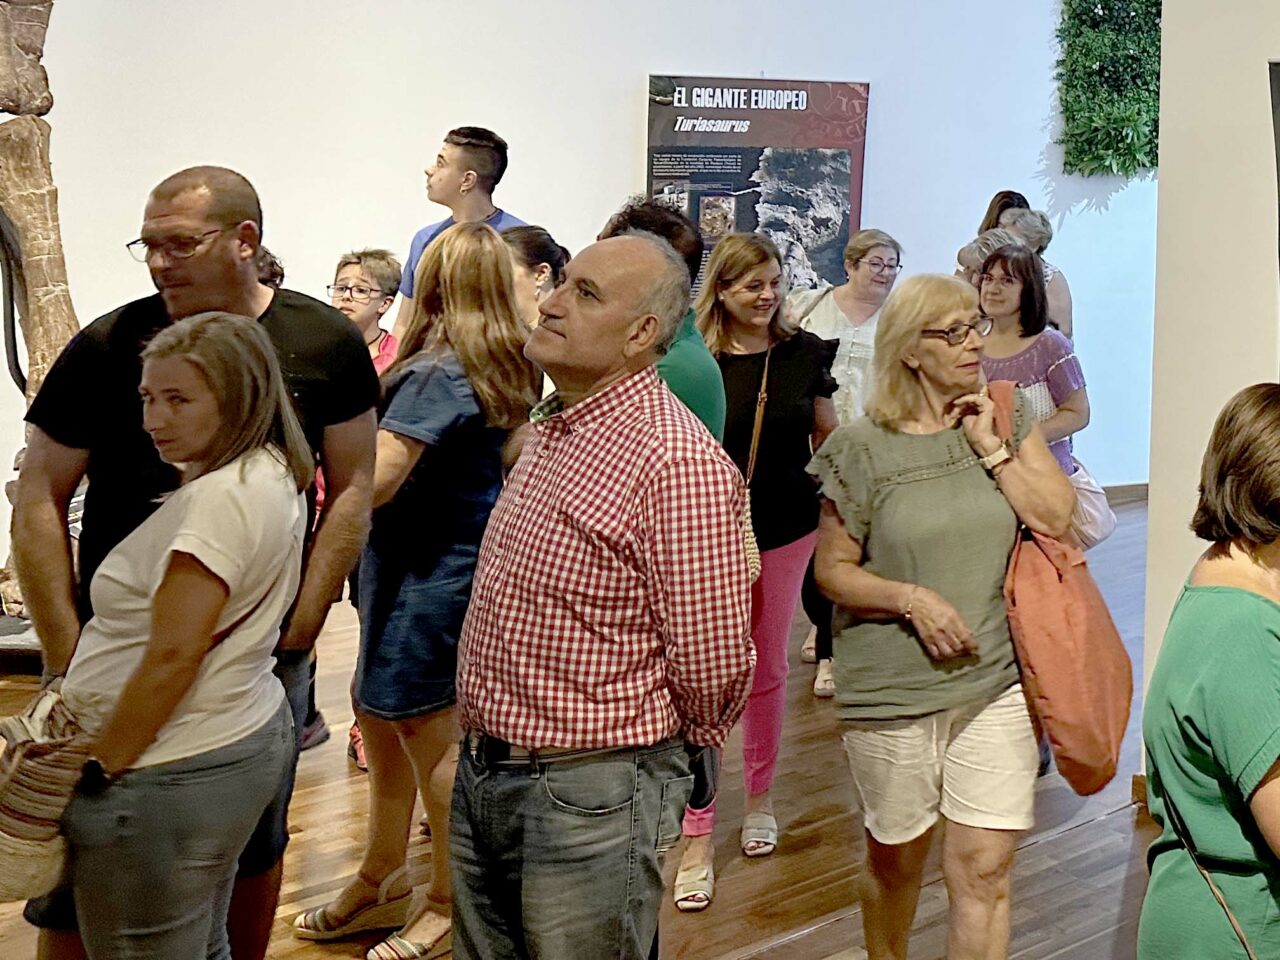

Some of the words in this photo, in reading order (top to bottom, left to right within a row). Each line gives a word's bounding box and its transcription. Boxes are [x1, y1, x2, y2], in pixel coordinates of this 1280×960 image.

[673, 87, 688, 108] EL
[692, 87, 747, 109] GIGANTE
[751, 90, 807, 110] EUROPEO
[673, 117, 750, 133] Turiasaurus
